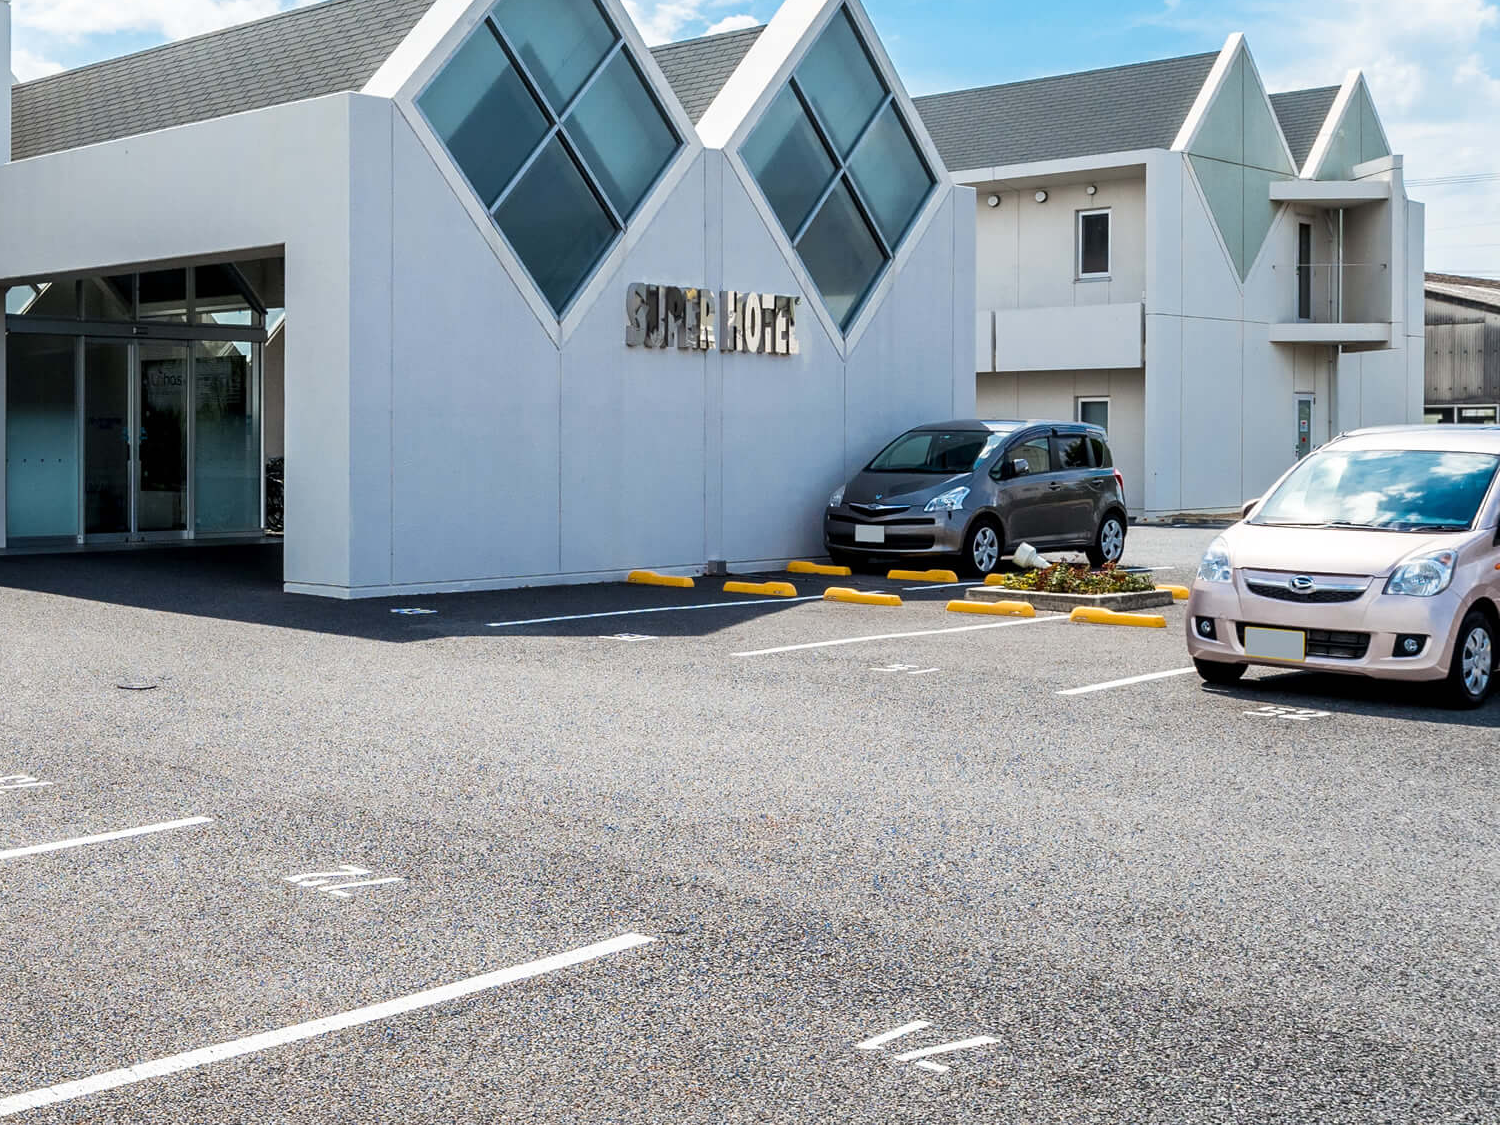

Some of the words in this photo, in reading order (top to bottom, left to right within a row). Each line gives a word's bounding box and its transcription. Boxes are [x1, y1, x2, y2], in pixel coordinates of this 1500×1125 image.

[625, 282, 717, 351] SUPER
[719, 290, 800, 356] HOTEL
[1243, 704, 1331, 721] 52
